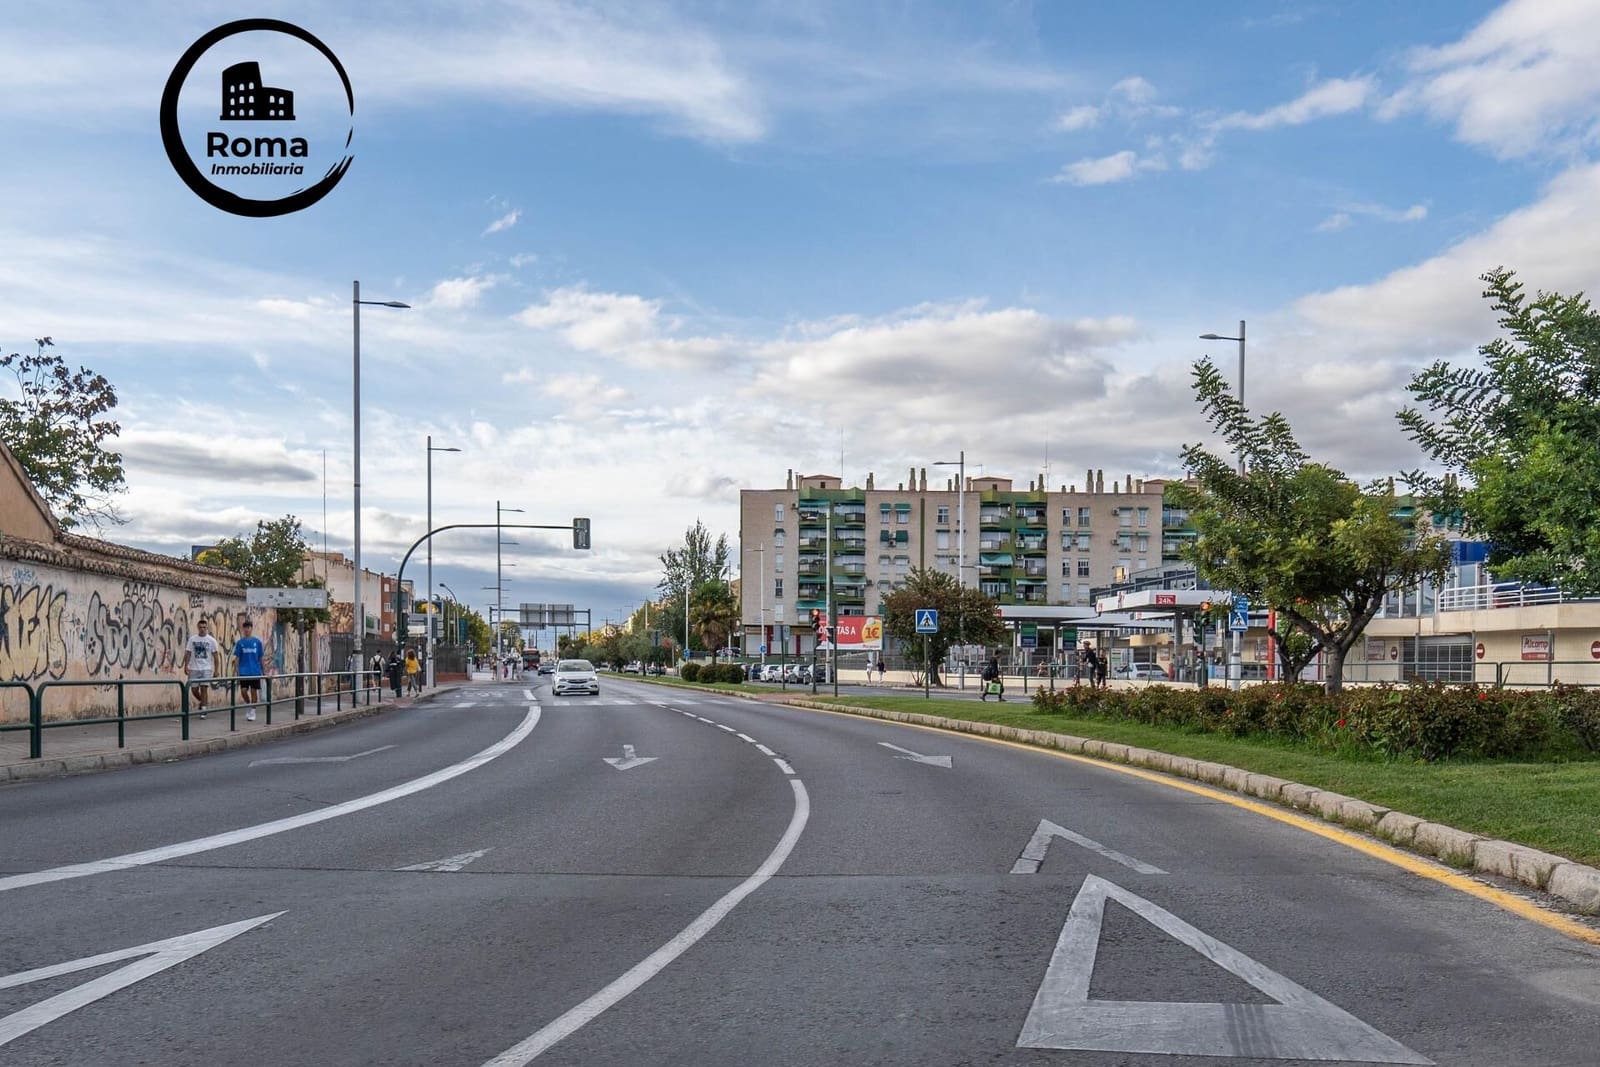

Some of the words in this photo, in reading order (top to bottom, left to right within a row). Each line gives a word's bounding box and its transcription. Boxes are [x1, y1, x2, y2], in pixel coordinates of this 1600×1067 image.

[819, 626, 849, 635] OFTAS
[850, 627, 856, 635] A
[865, 627, 880, 639] 1€
[1523, 637, 1551, 650] Alcamp
